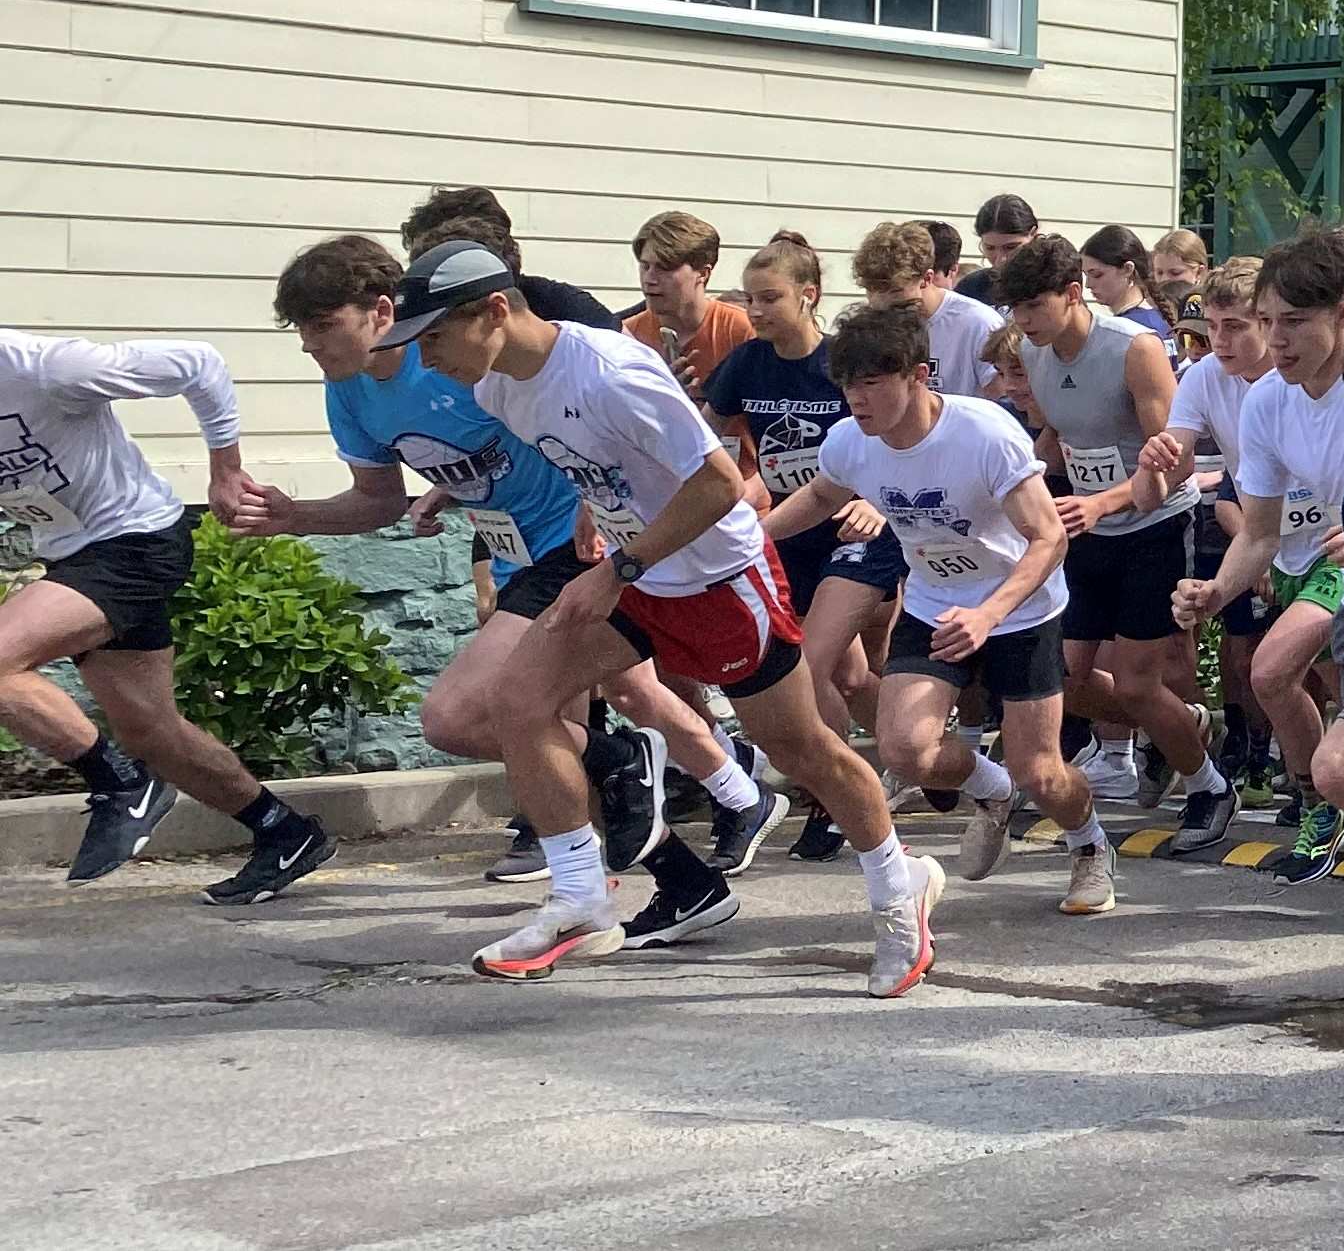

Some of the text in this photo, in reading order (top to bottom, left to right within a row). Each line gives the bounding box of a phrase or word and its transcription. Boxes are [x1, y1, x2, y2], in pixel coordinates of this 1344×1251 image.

[774, 465, 820, 489] 110
[1070, 463, 1115, 483] 1217
[928, 555, 978, 577] 950
